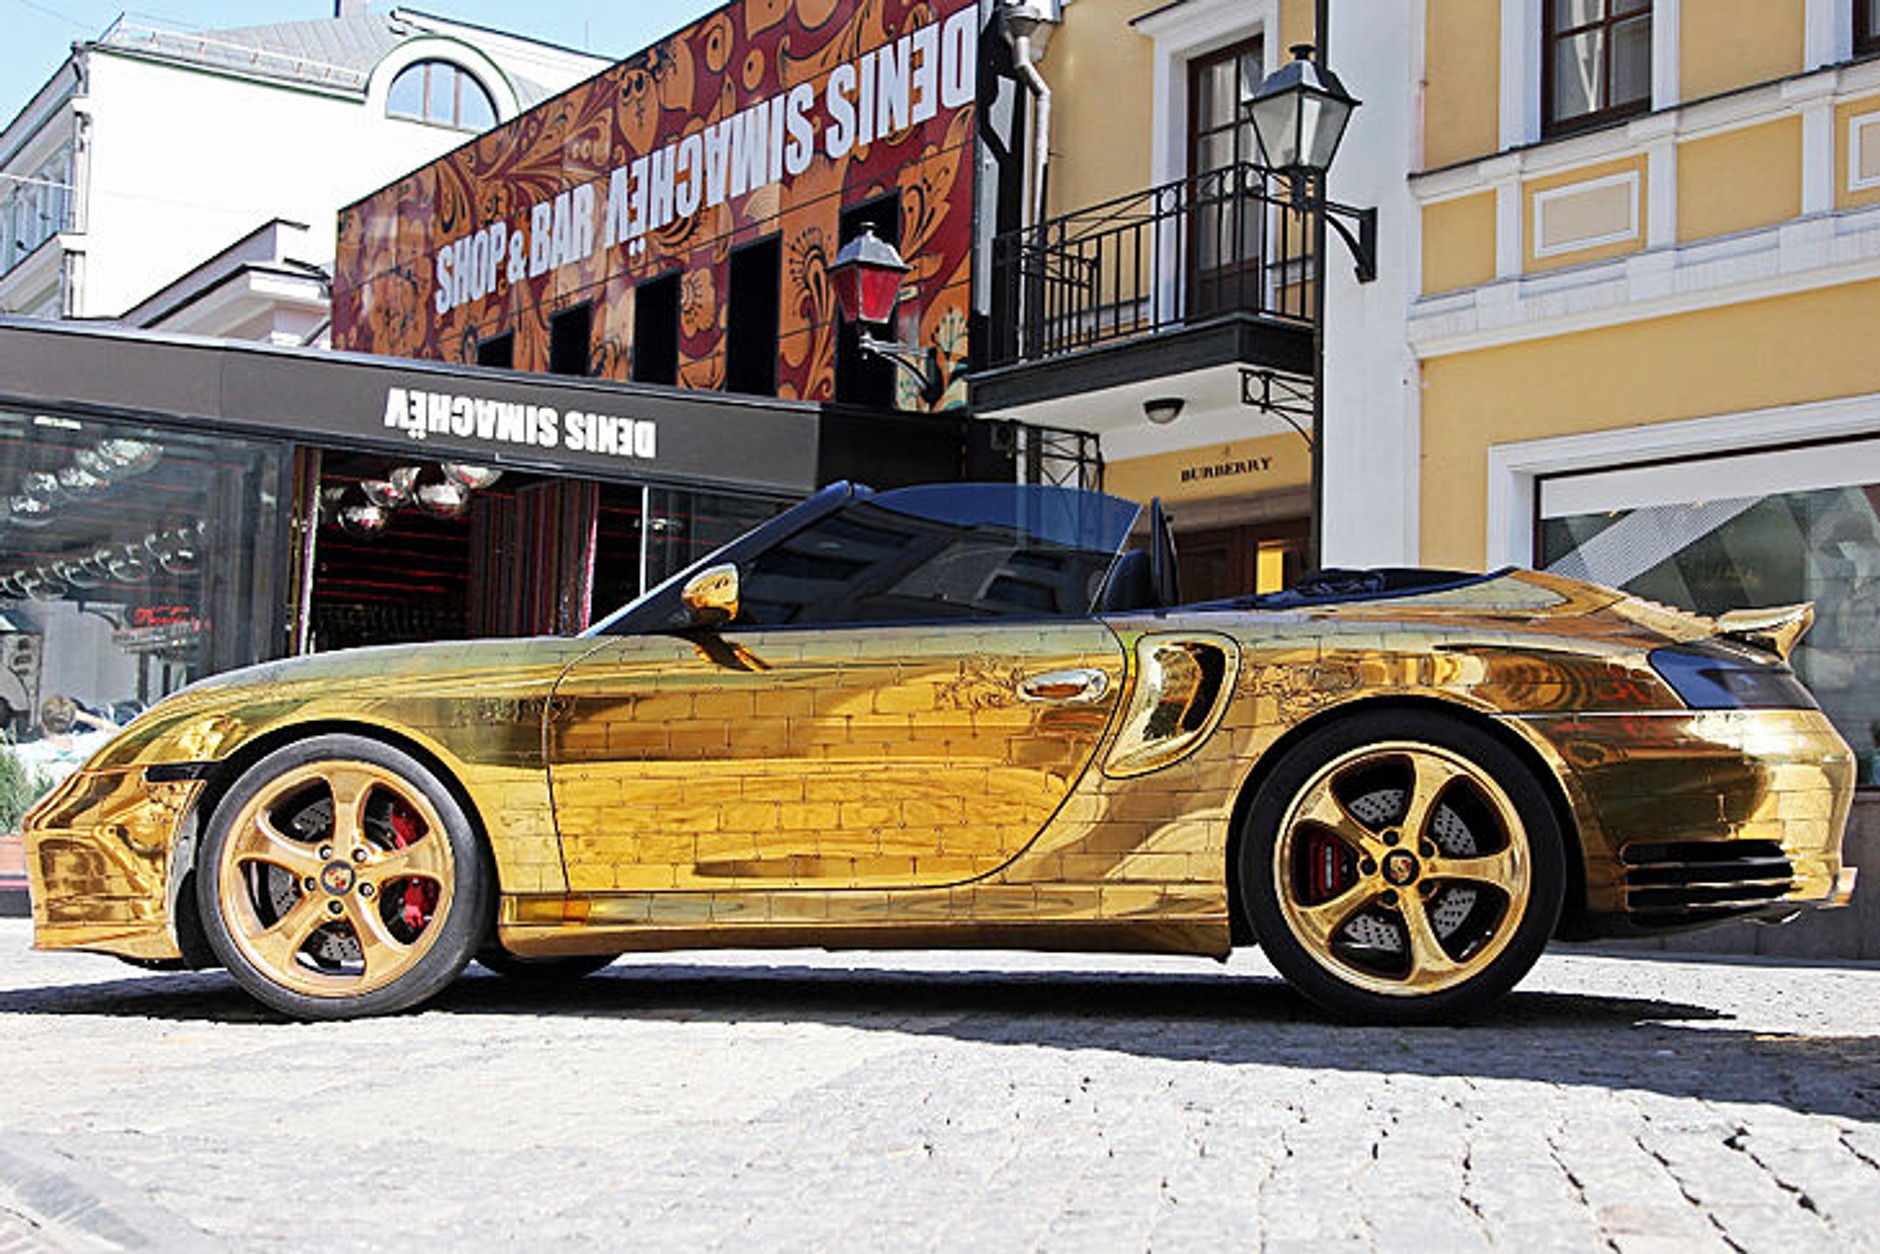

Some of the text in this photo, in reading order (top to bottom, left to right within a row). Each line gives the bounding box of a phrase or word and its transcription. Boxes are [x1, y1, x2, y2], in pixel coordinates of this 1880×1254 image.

[825, 3, 979, 160] DENIS
[564, 410, 657, 459] DENIS
[1180, 456, 1273, 483] BURBERRY
